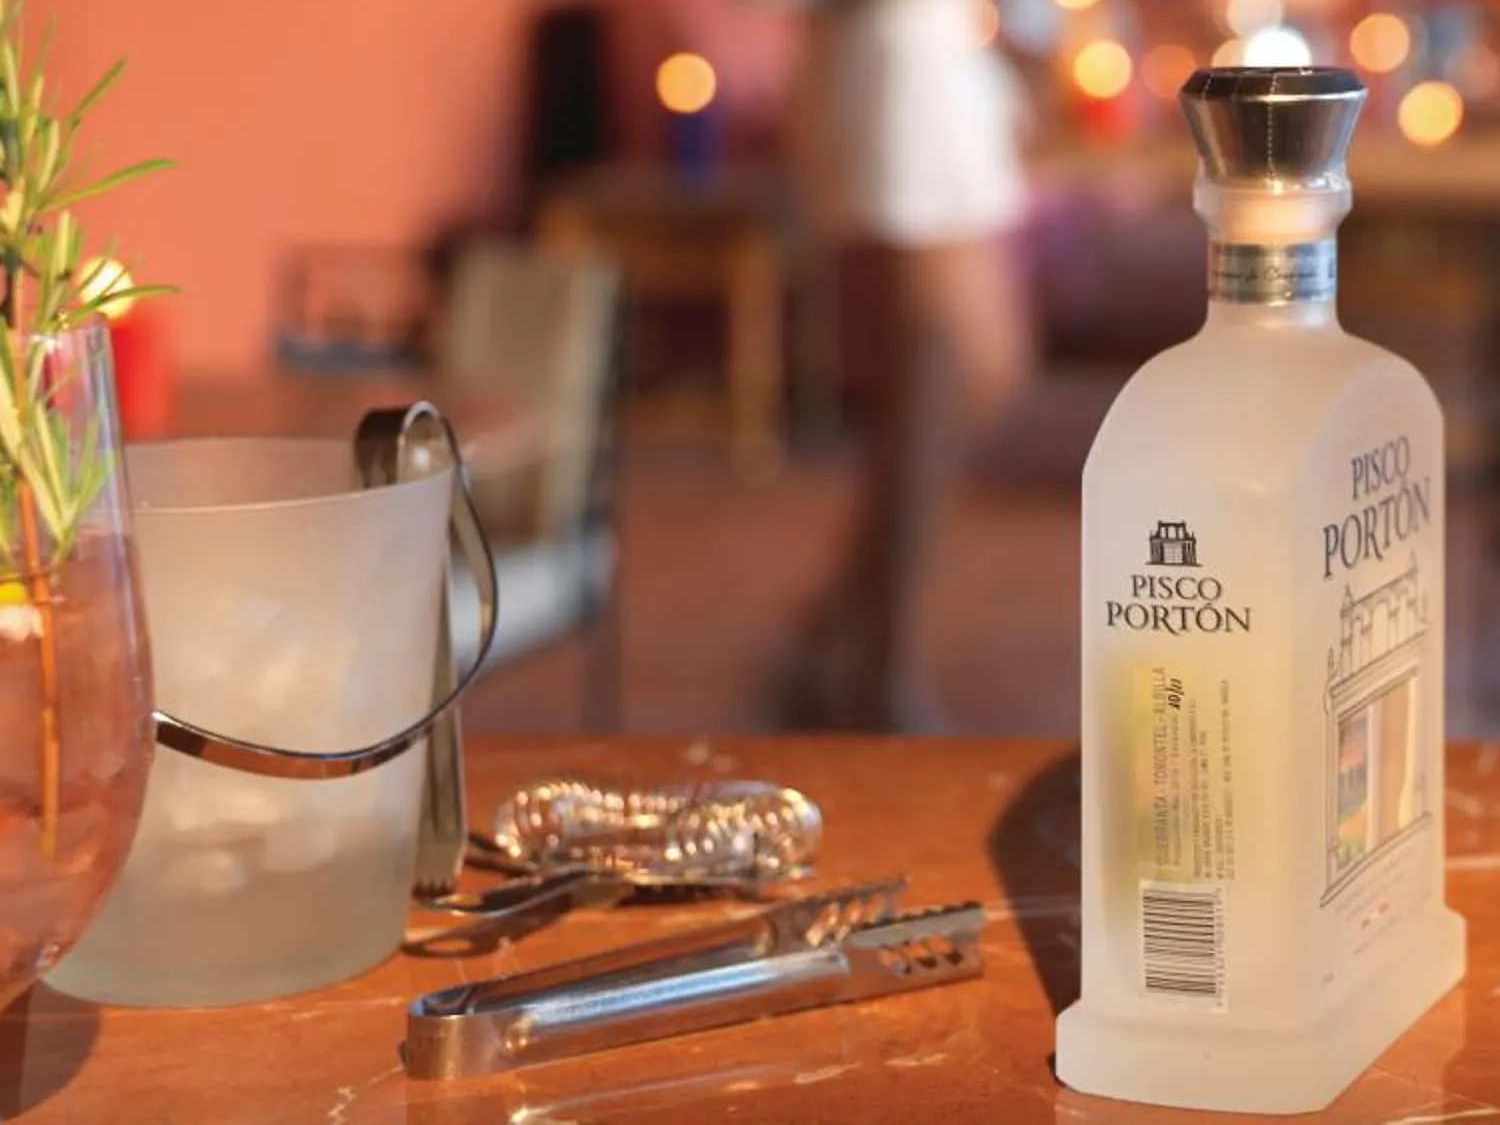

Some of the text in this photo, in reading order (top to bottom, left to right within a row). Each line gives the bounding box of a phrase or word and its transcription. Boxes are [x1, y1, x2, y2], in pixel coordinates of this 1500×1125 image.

[1351, 435, 1411, 501] PISCO
[1131, 574, 1222, 601] PISCO
[1106, 601, 1252, 636] PORTÓN
